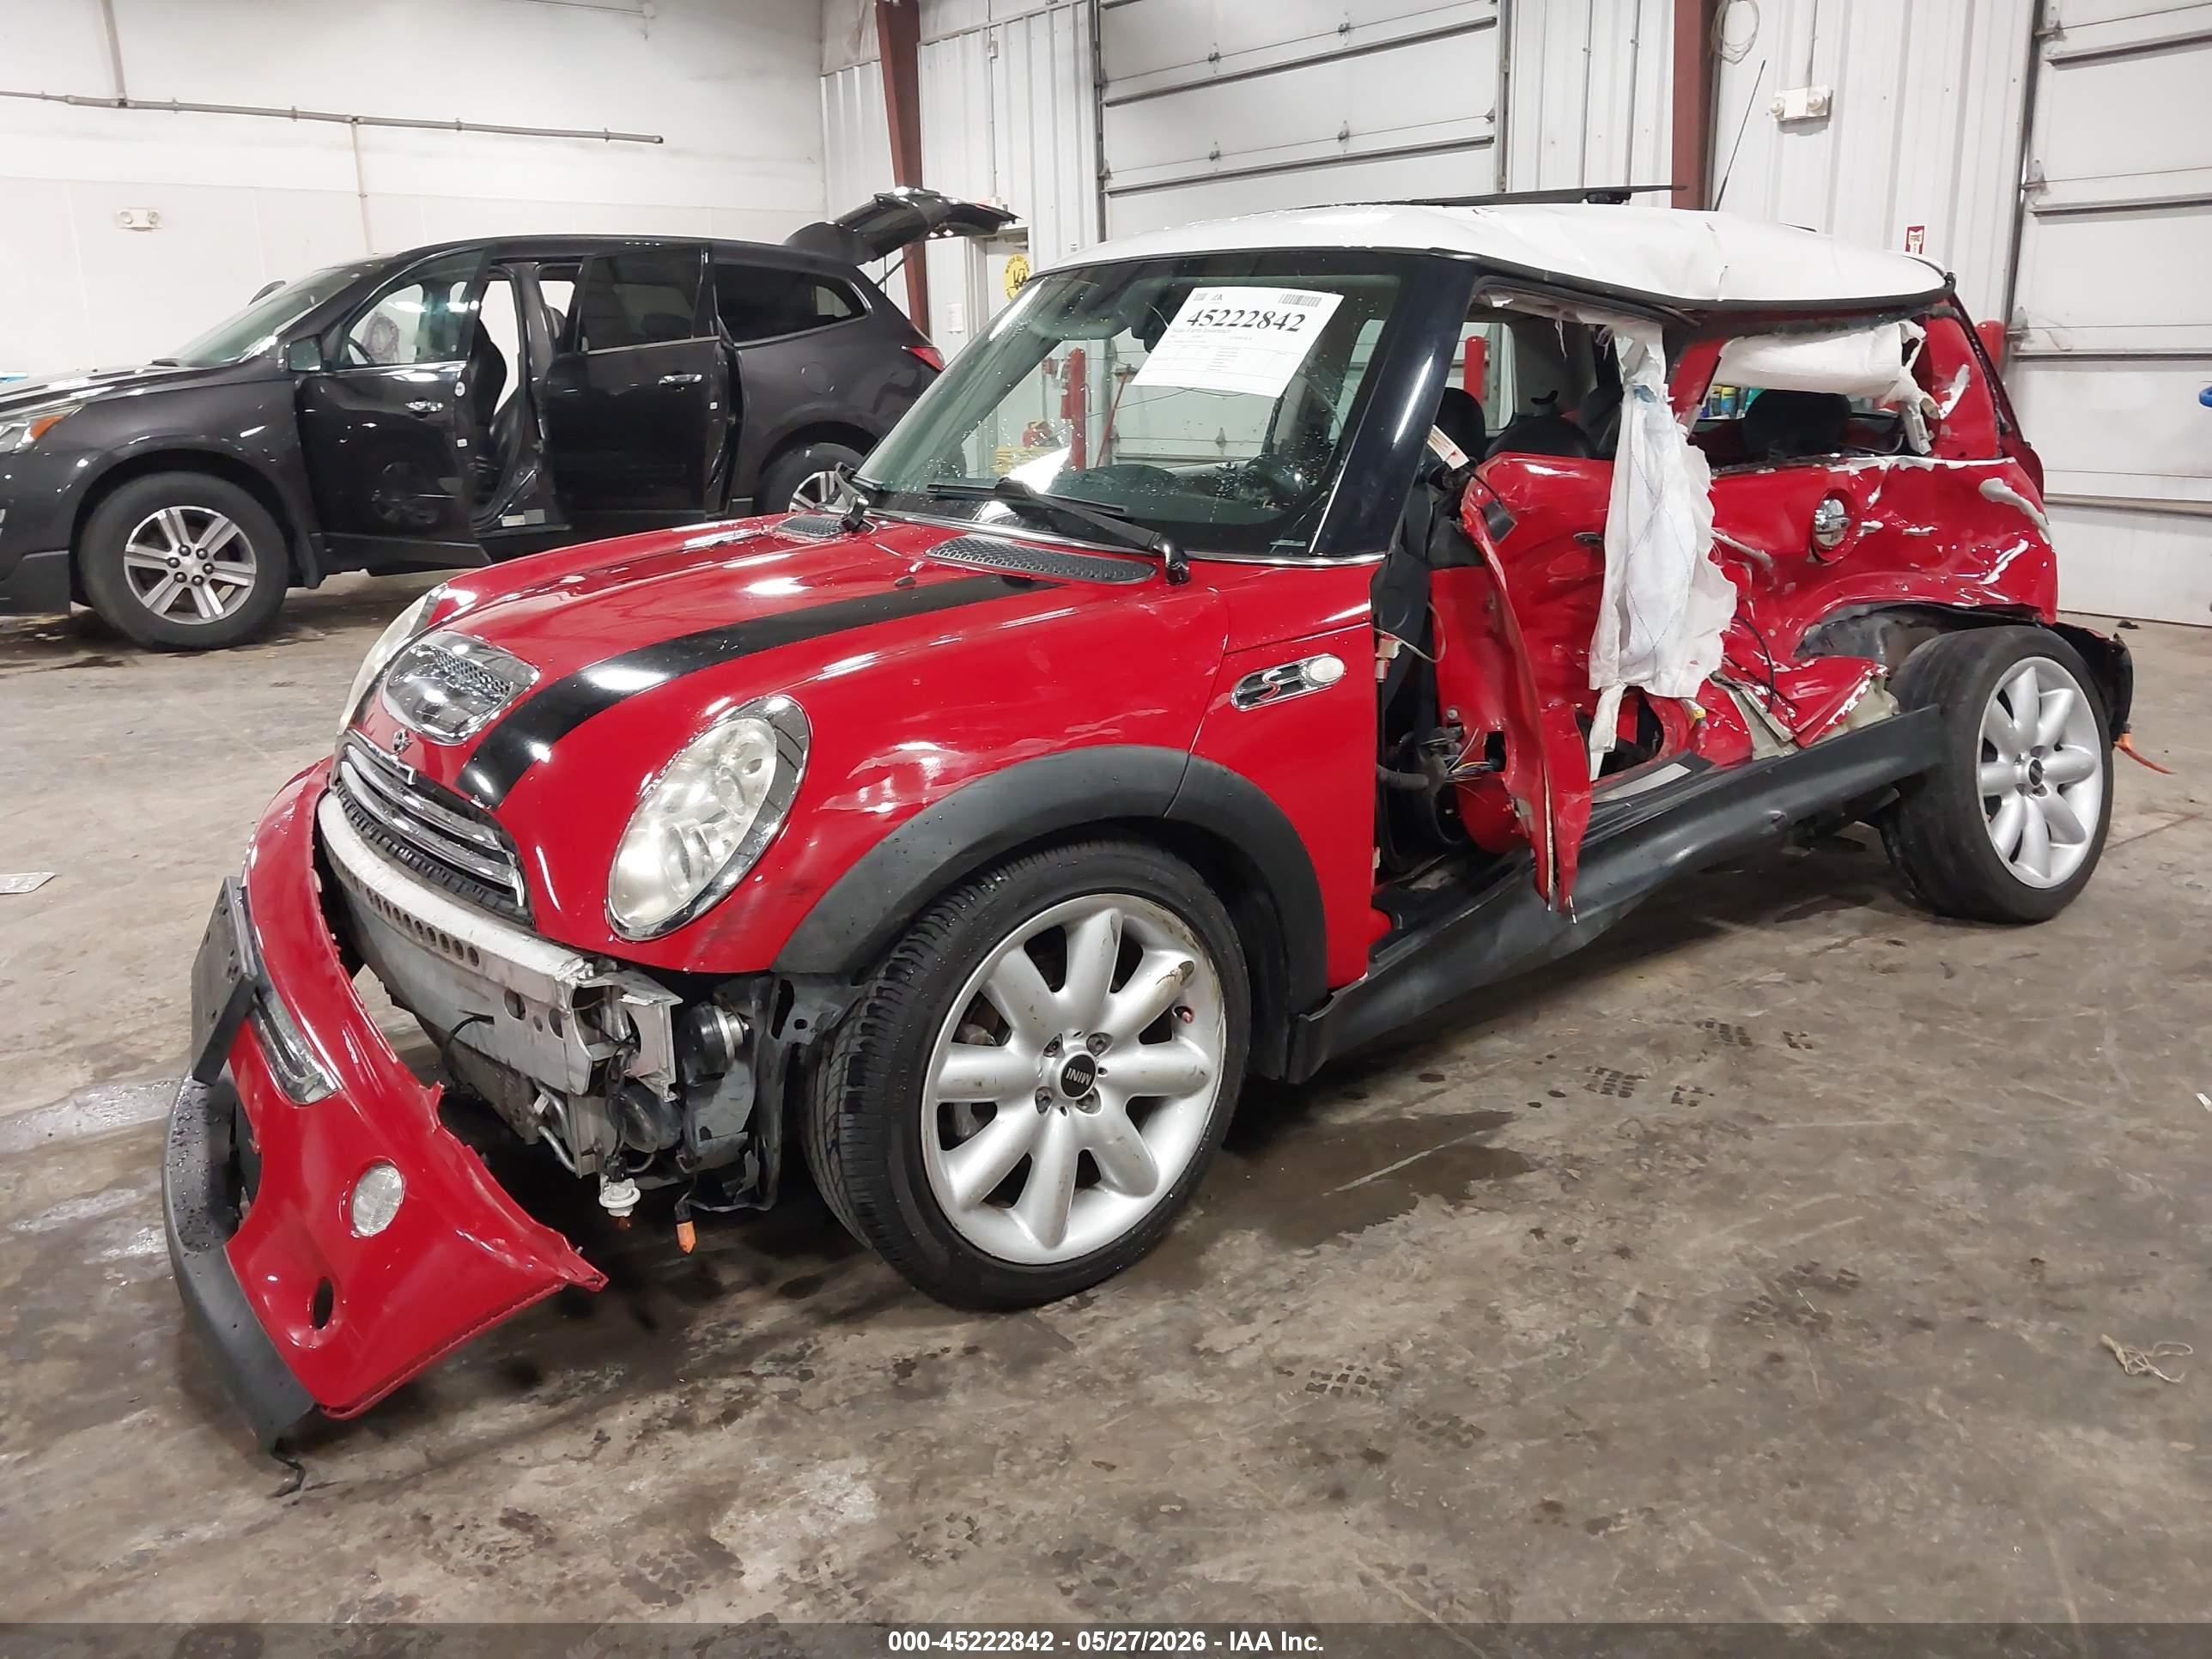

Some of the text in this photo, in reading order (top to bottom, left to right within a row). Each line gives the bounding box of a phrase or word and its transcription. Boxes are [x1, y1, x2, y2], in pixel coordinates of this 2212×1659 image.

[1187, 309, 1306, 332] 45222842
[1255, 670, 1282, 702] S
[1066, 1067, 1092, 1086] MINI
